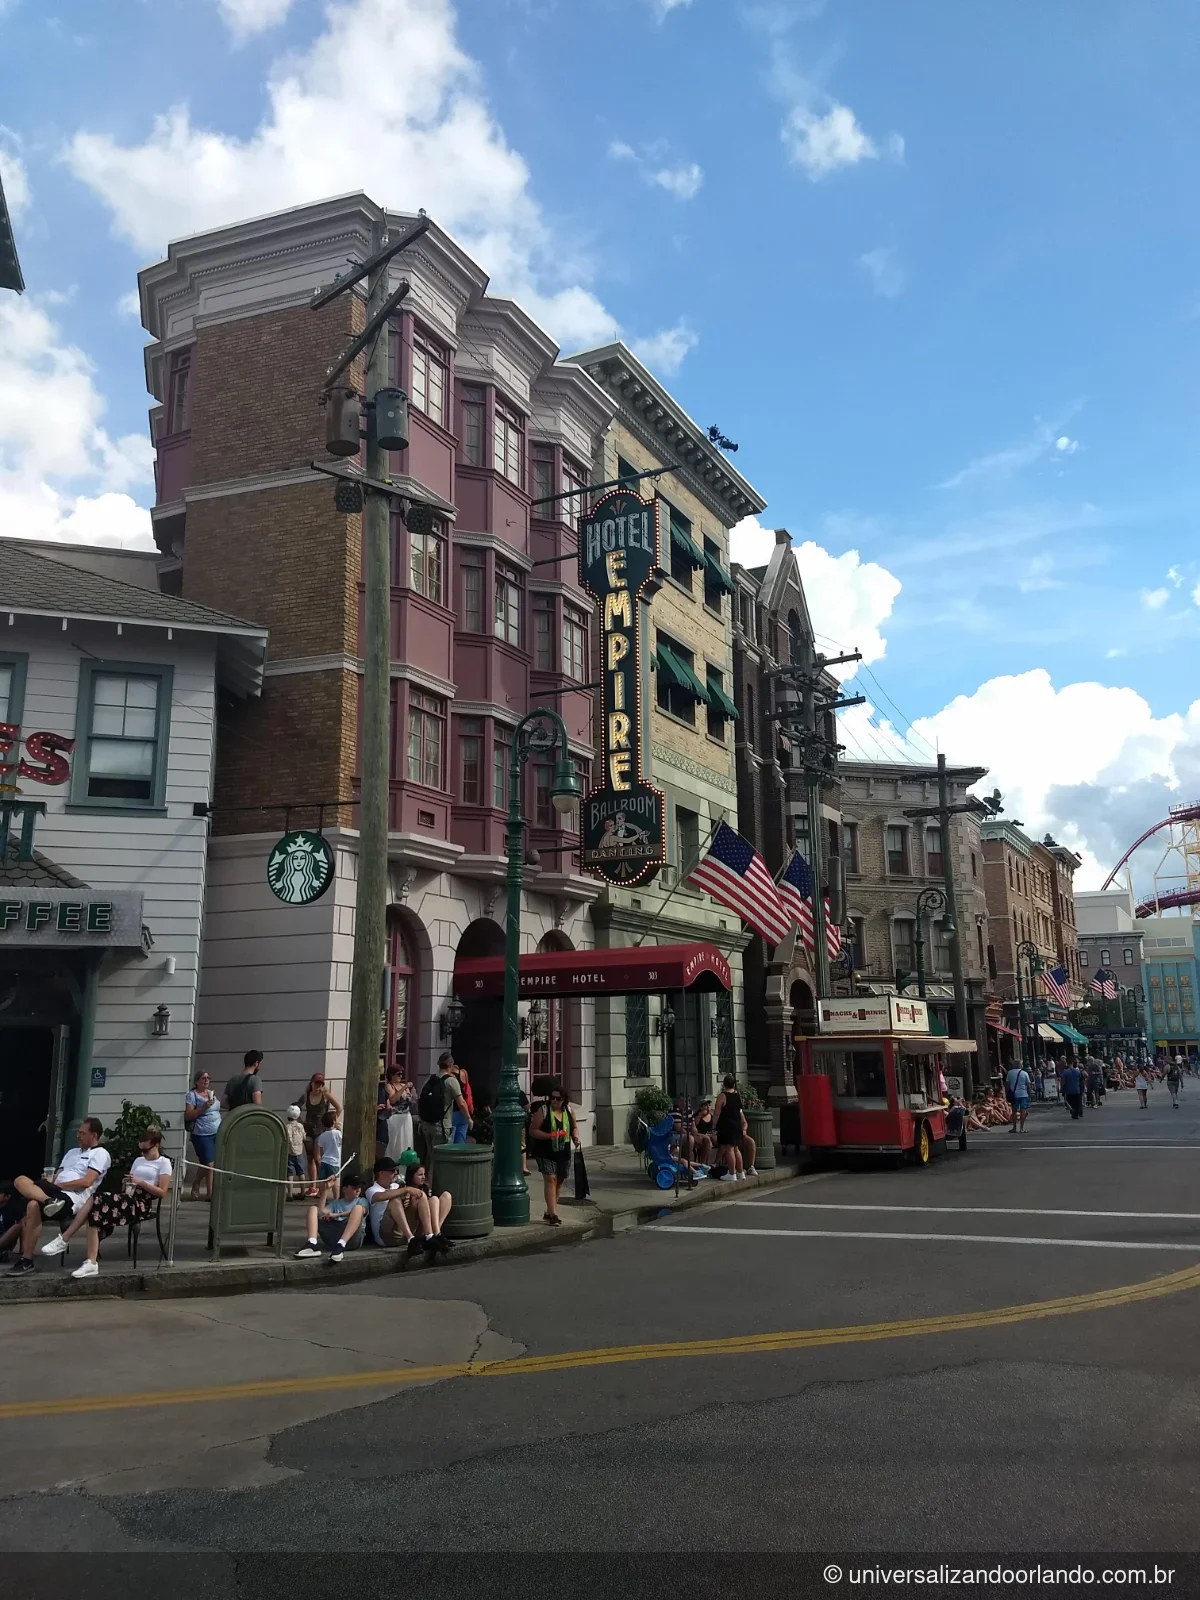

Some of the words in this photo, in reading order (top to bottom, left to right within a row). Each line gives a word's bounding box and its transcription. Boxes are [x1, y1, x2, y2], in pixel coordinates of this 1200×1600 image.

[586, 511, 654, 569] HOTEL
[604, 550, 632, 792] EMPIRE
[0, 799, 47, 862] T
[591, 795, 656, 831] BALLROOM
[520, 975, 557, 986] EMPIRE
[572, 973, 606, 984] HOTEL
[647, 971, 658, 981] 303
